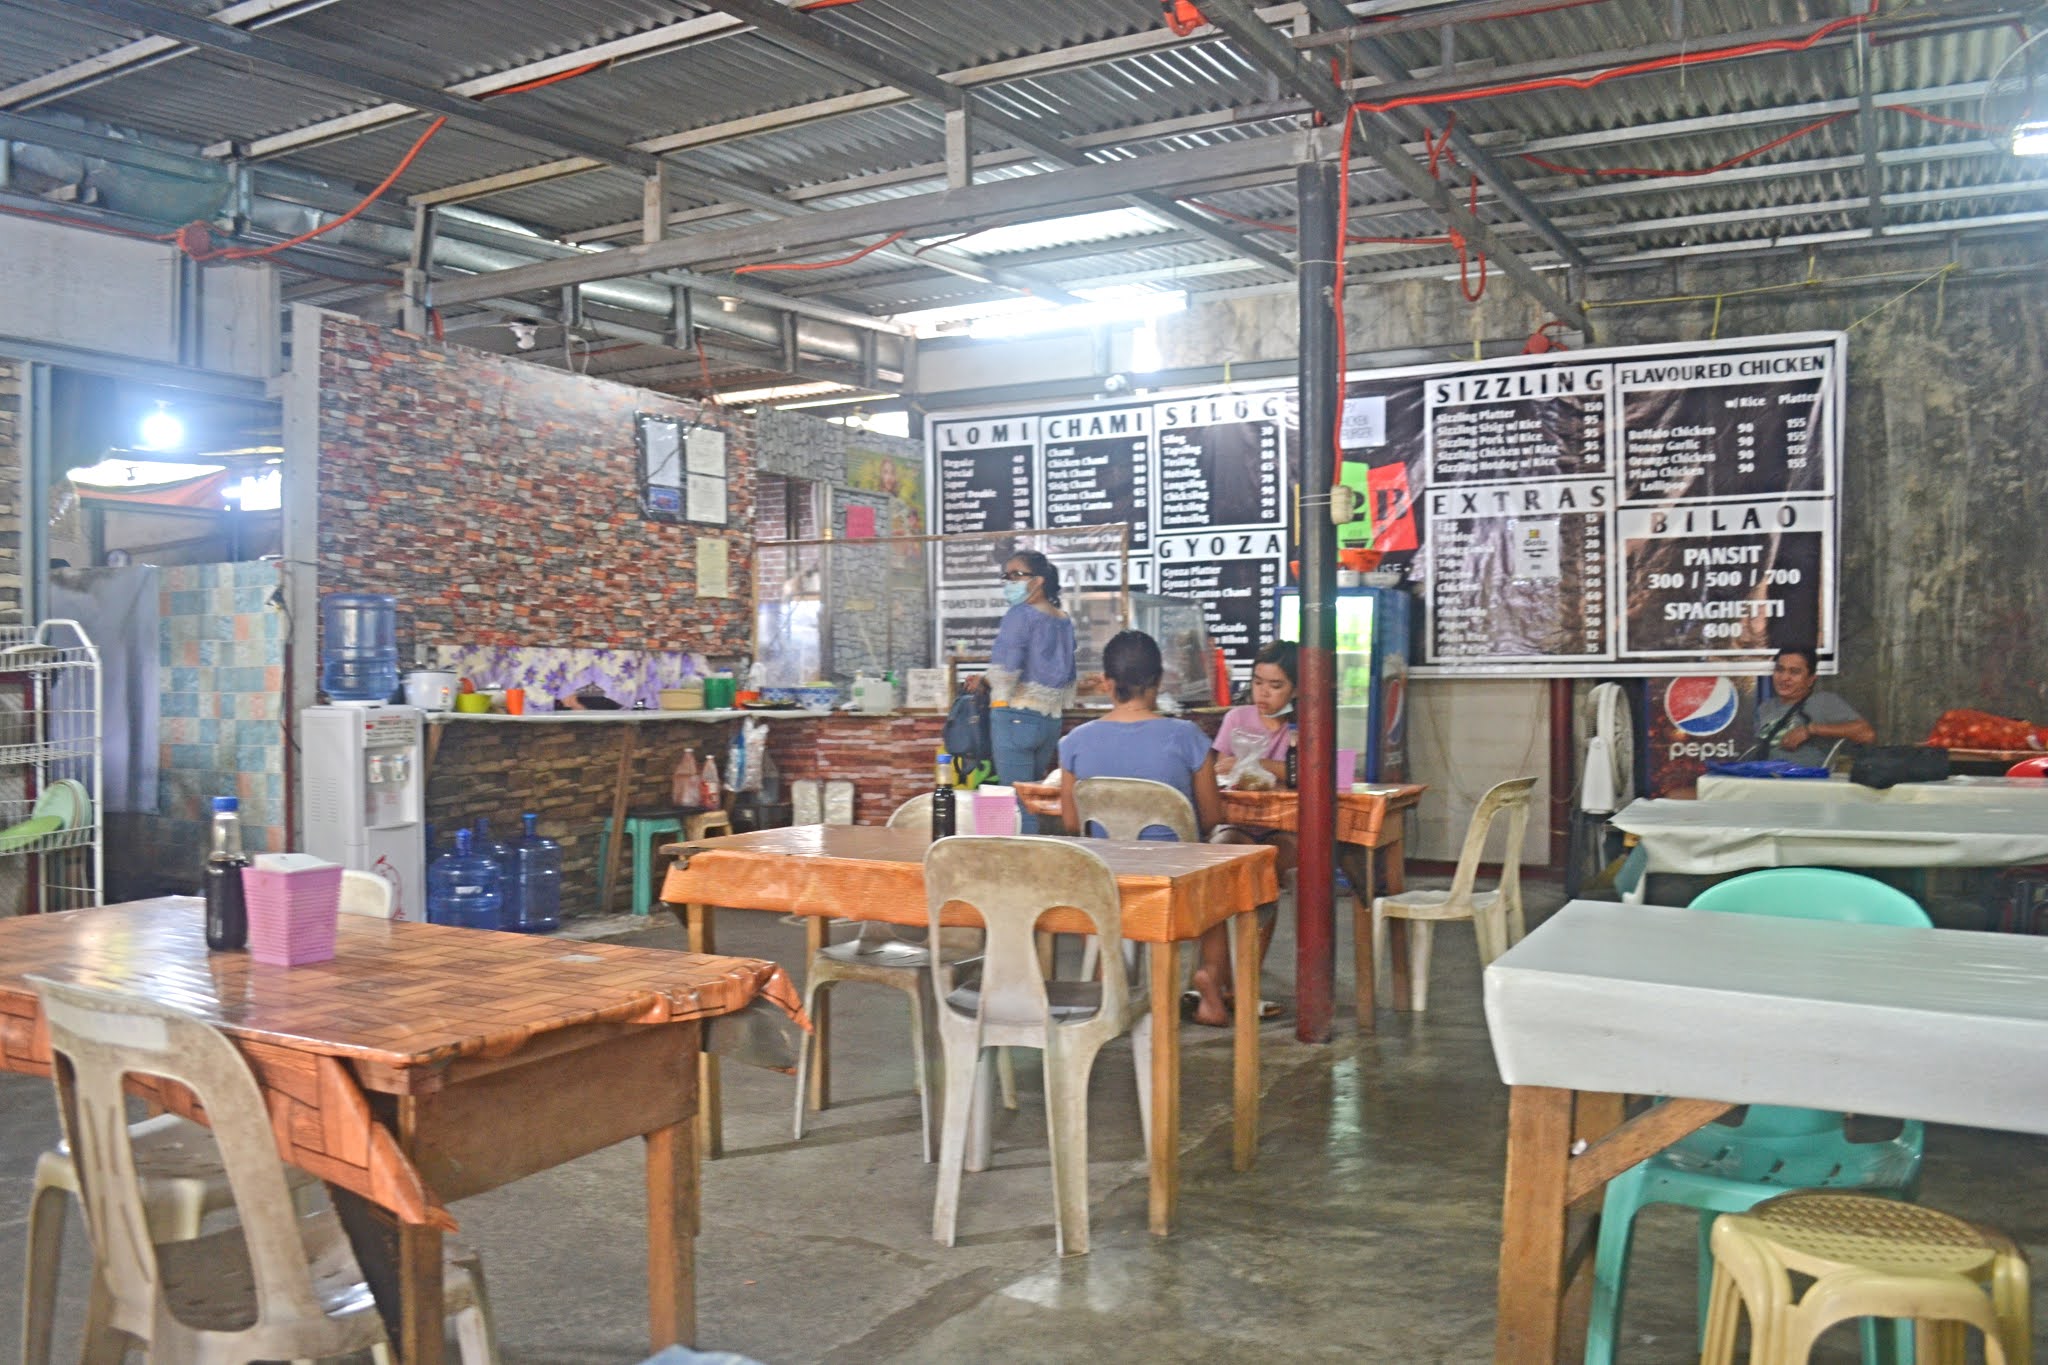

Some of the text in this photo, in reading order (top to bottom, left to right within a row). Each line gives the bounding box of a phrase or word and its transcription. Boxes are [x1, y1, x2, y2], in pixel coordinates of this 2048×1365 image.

[1621, 355, 1825, 384] FLAVOURED CHICKEN
[1437, 369, 1603, 403] SIZZLING
[1739, 396, 1766, 407] Rice
[1778, 392, 1820, 405] Platter
[1166, 397, 1278, 426] SILOG
[1583, 414, 1599, 425] 95
[947, 422, 1028, 446] LOMI
[1048, 413, 1142, 439] CHAMI
[1583, 427, 1599, 438] 95
[1671, 424, 1716, 438] Chicken
[1737, 422, 1754, 434] 90
[1787, 417, 1806, 428] 155
[1584, 440, 1600, 451] 95
[1737, 436, 1754, 447] 90
[1787, 431, 1807, 442] 155
[1671, 451, 1716, 464] Chicken
[1737, 449, 1755, 460] 90
[1659, 464, 1705, 477] Chicken
[1737, 462, 1755, 474] 90
[1787, 458, 1807, 469] 155
[1433, 486, 1605, 515] EXTRAS
[1651, 505, 1797, 533] BILAO
[1159, 534, 1281, 559] GYOZA
[1683, 545, 1763, 566] PANSIT
[1648, 573, 1684, 589] 300
[1705, 571, 1742, 586] 500
[1765, 569, 1801, 585] 700
[1664, 599, 1785, 620] SPAGHETTI
[1669, 739, 1735, 761] pepsi
